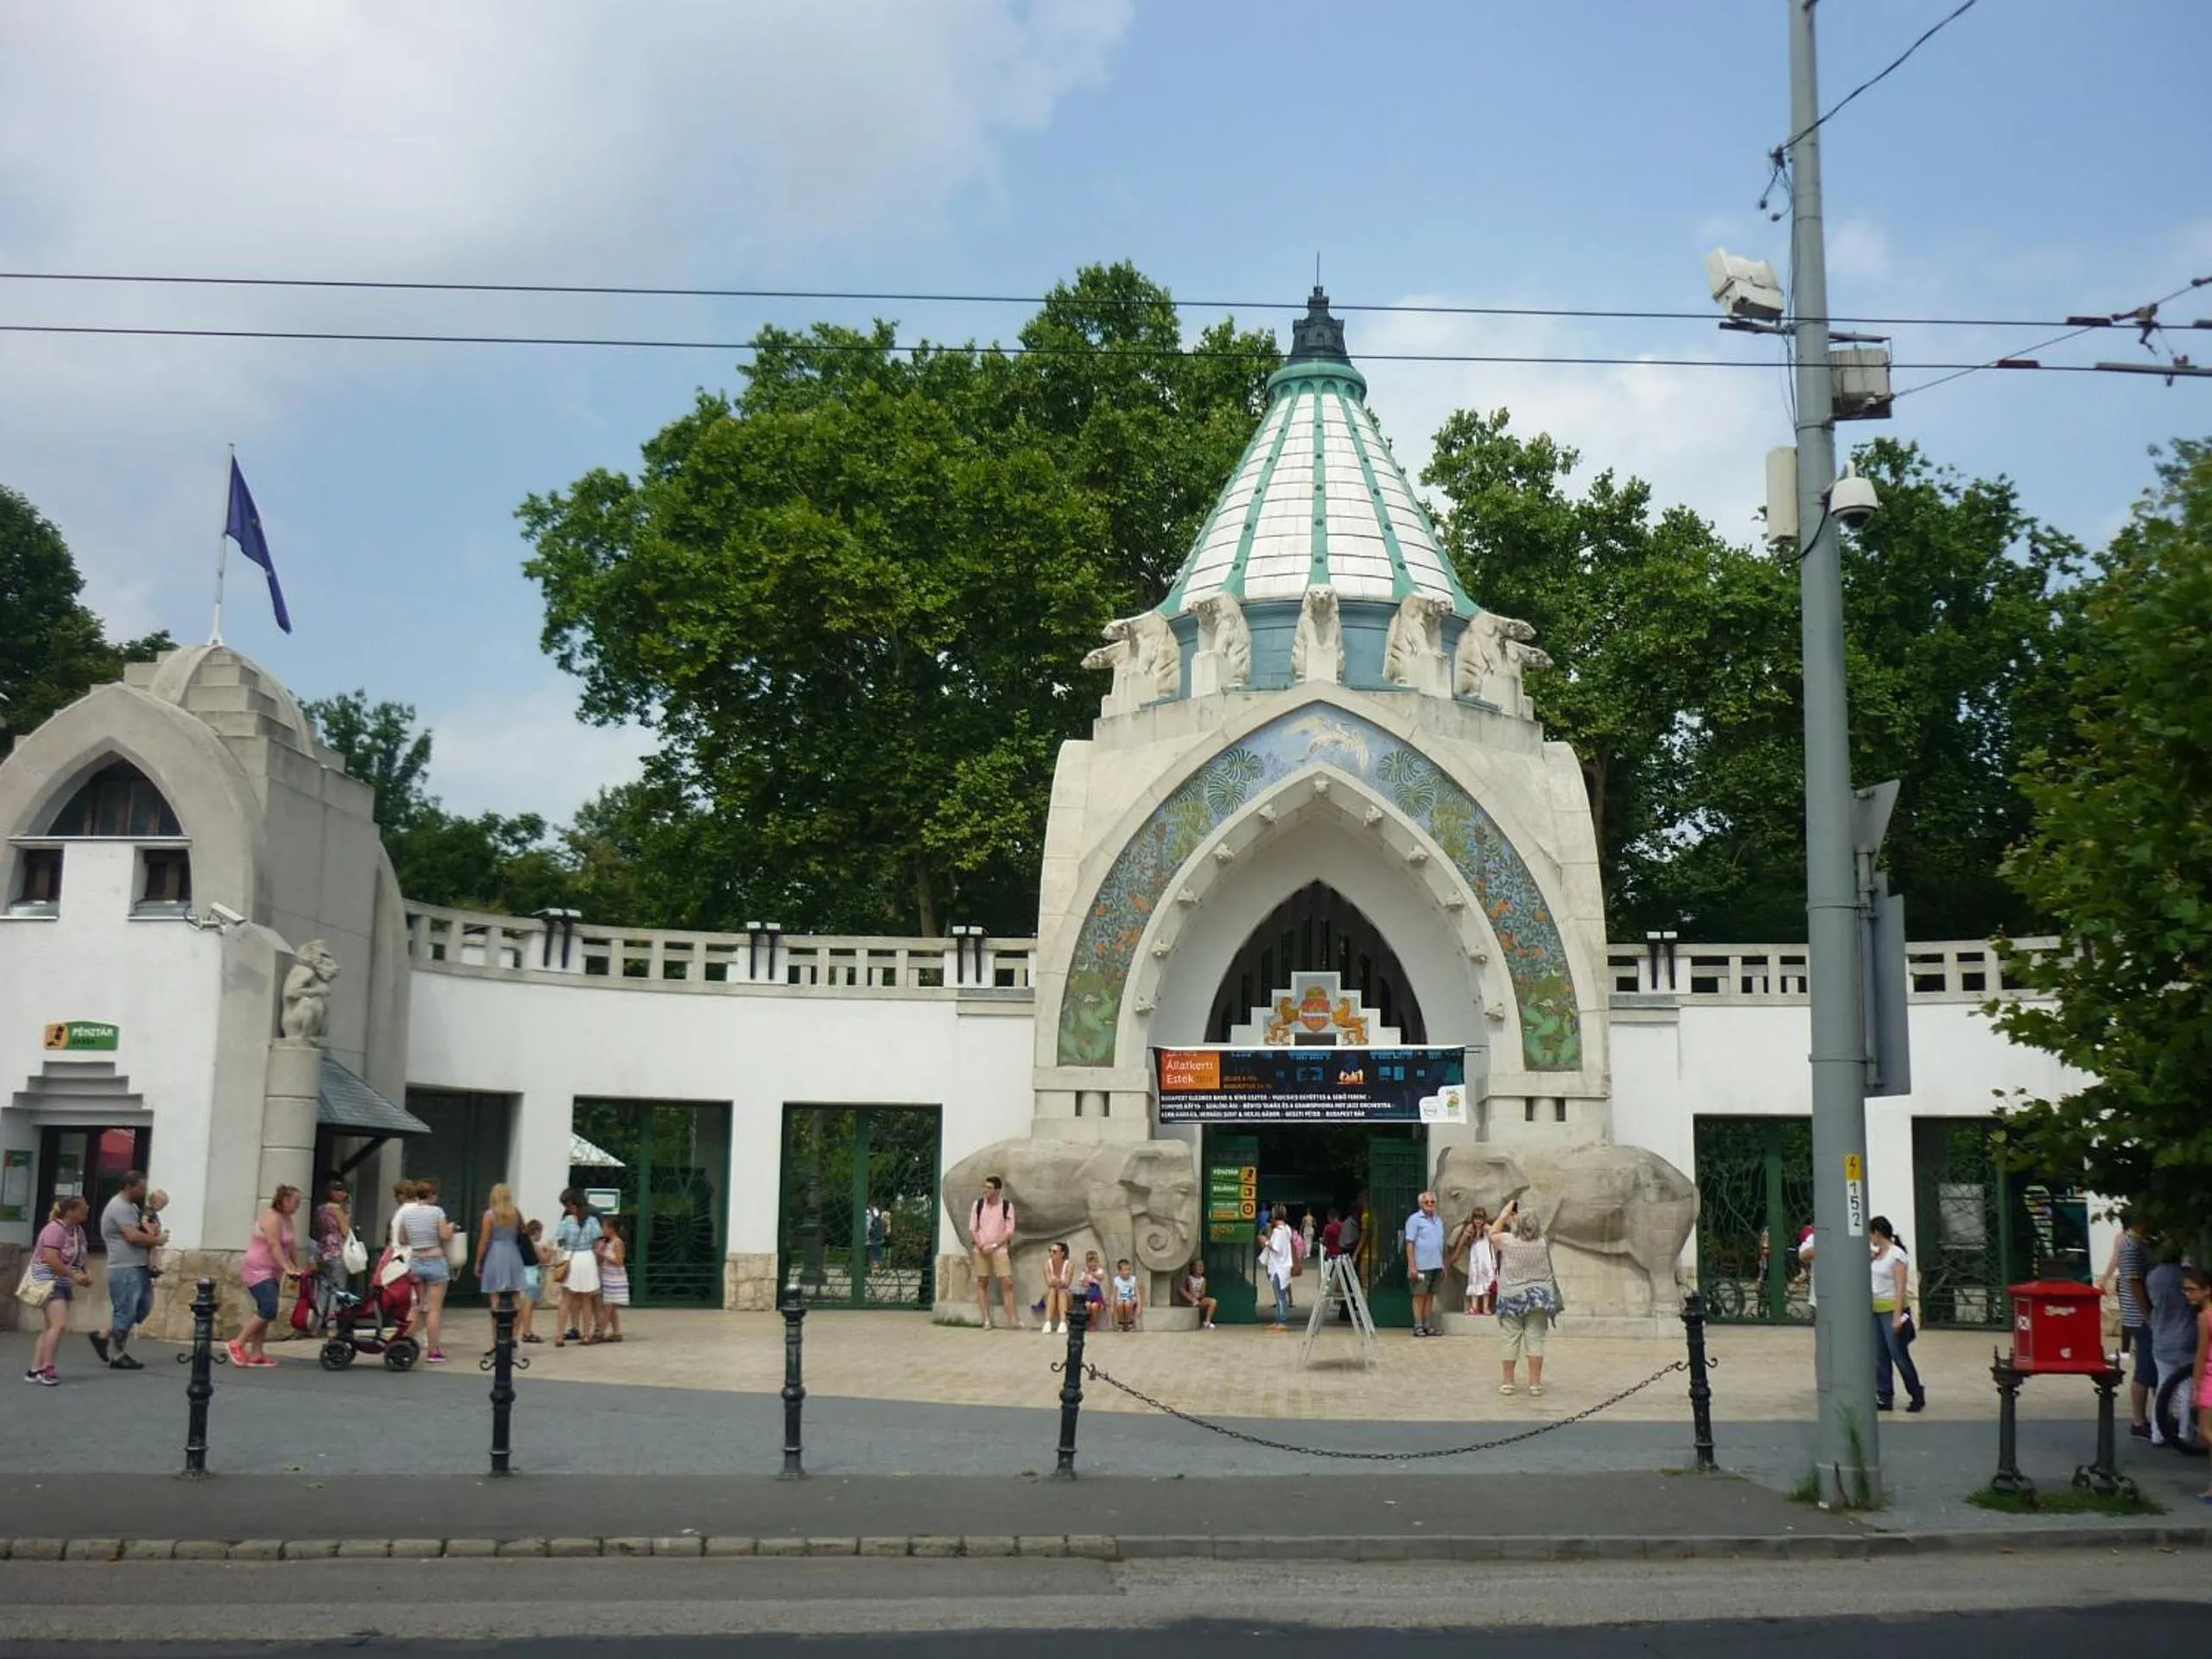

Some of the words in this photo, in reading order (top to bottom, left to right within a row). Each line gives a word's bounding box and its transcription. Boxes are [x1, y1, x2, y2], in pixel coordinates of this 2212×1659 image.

[72, 1025, 114, 1038] PÉNZTÁR
[1166, 1059, 1213, 1071] Állatkerti
[1166, 1073, 1194, 1084] Esték
[1849, 1181, 1861, 1227] 152
